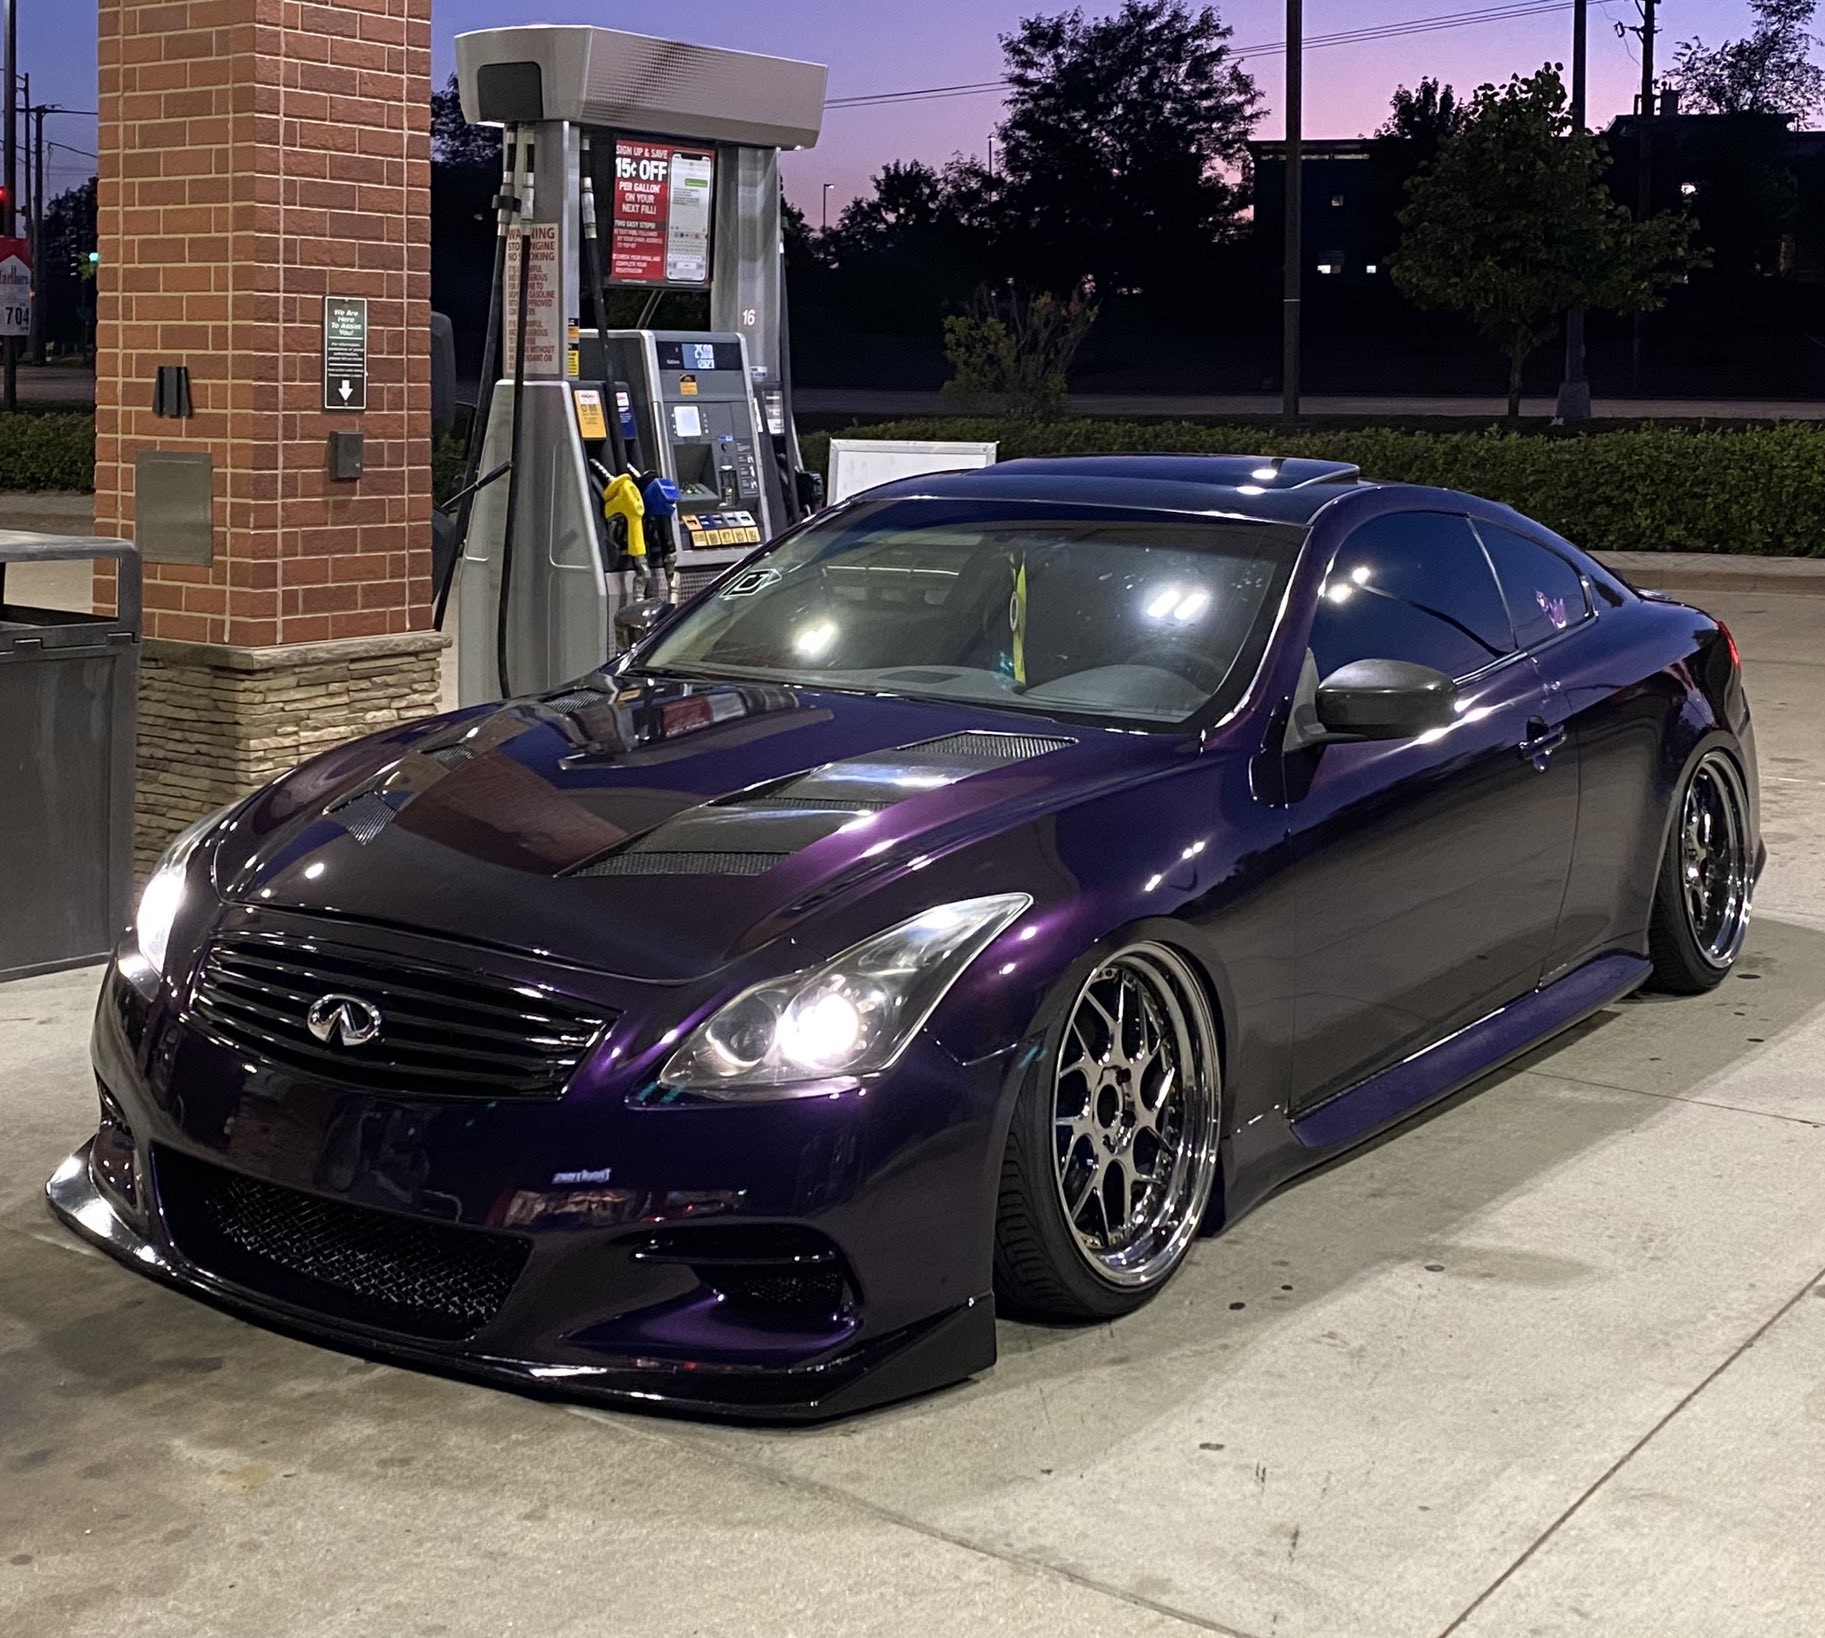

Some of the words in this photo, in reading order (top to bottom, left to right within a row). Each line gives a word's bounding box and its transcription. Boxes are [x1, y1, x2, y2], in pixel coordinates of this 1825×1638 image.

[616, 144, 632, 156] SIGN
[633, 146, 643, 156] UP
[644, 148, 650, 157] &
[651, 149, 668, 159] SAVE
[615, 157, 637, 178] 15¢
[639, 160, 668, 181] OFF
[619, 181, 633, 191] PER
[625, 193, 635, 202] ON
[636, 194, 654, 203] YOUR
[622, 203, 640, 213] NEXT
[530, 241, 556, 251] NGINE
[346, 309, 359, 317] Are
[742, 309, 756, 326] 16
[331, 321, 340, 329] To
